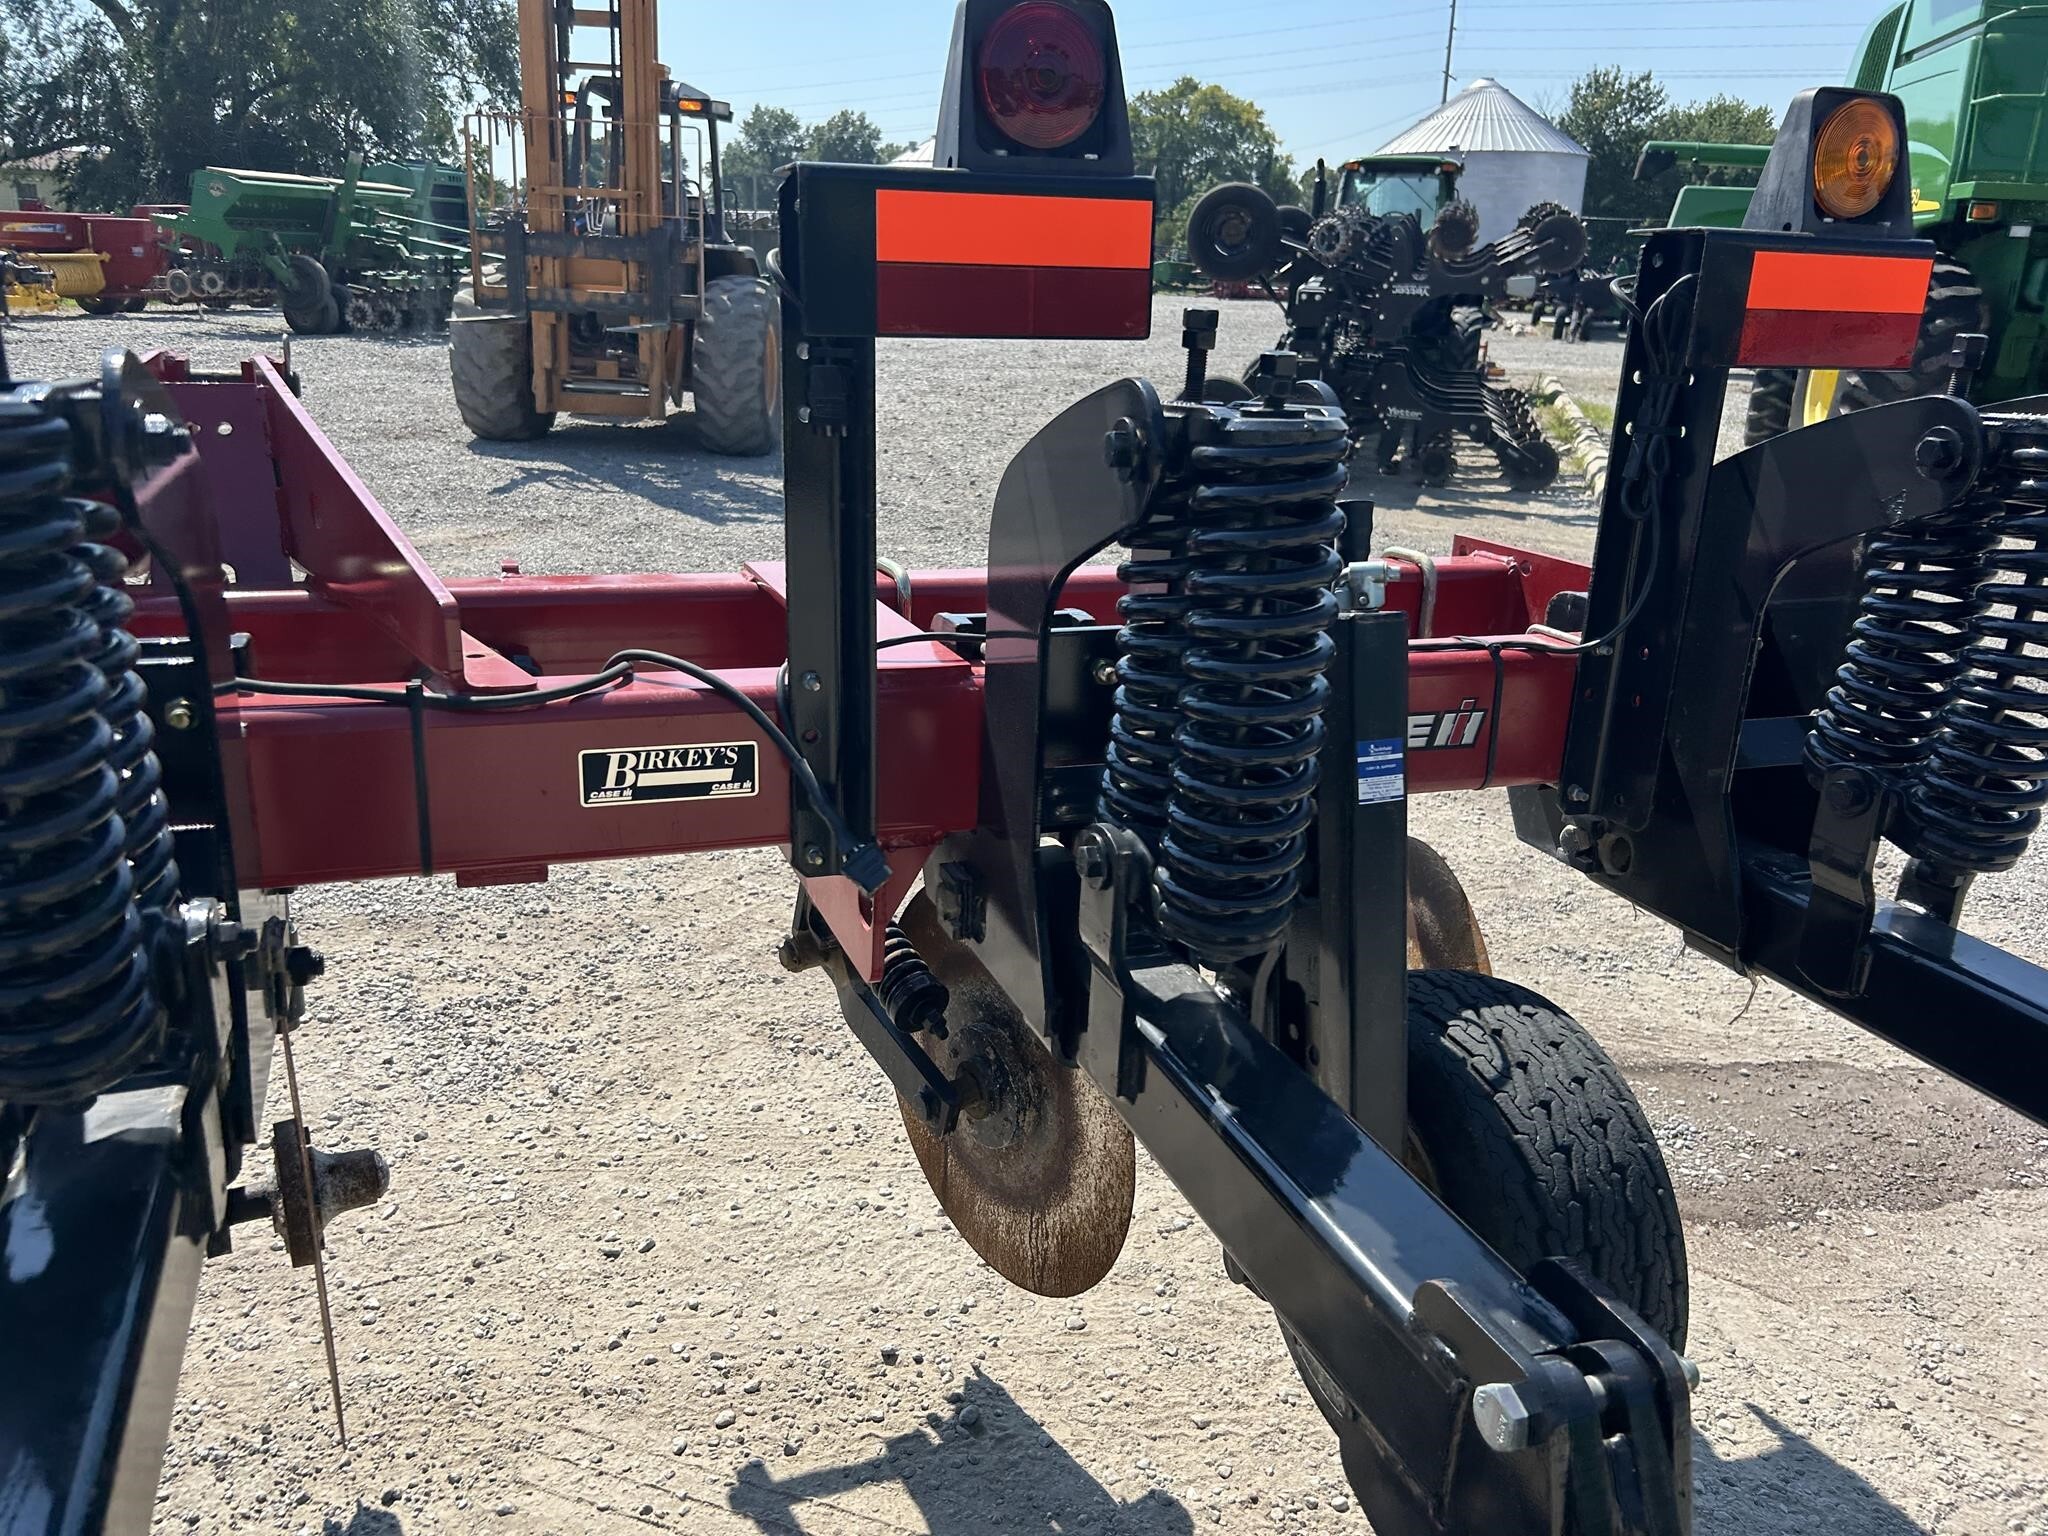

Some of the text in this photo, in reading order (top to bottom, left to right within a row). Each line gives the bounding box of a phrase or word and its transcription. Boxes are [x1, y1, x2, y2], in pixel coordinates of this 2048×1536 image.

[601, 746, 739, 790] BIRKEY'S
[711, 782, 741, 791] CASE
[590, 790, 621, 799] CASE
